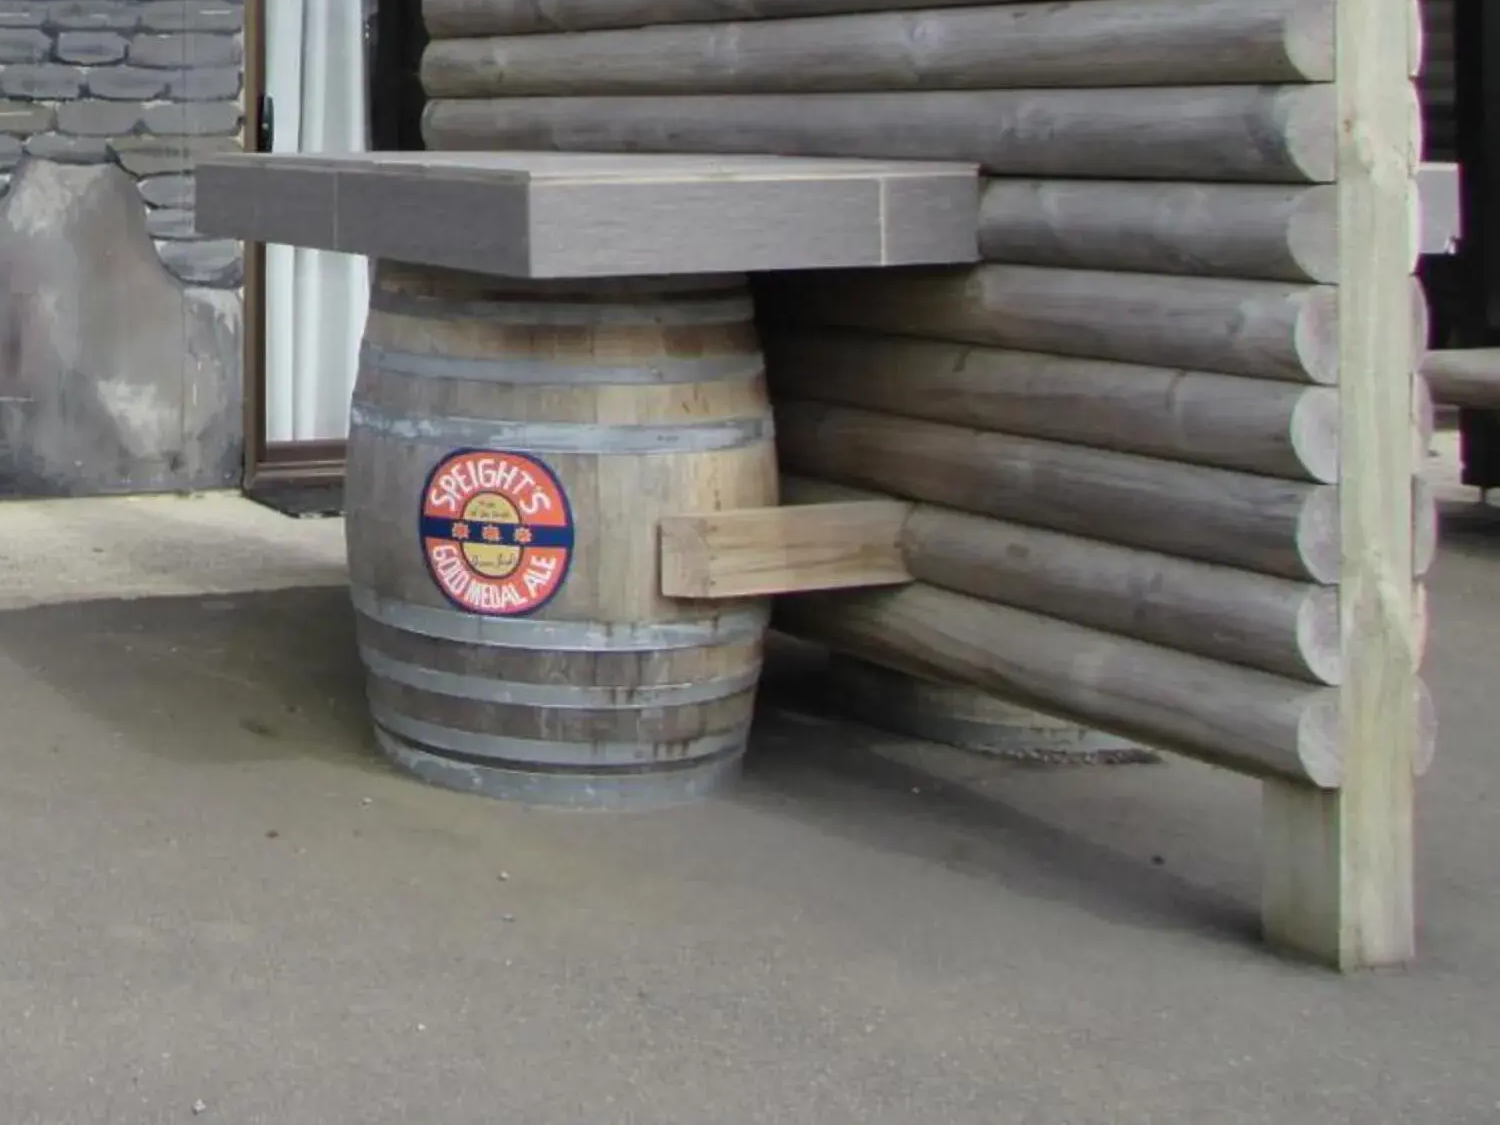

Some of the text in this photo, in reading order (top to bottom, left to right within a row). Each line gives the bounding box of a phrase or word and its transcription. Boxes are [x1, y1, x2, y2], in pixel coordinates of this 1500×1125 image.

[430, 458, 552, 515] SPEIGHT'S
[432, 544, 556, 609] GOLD MEDAL ALE
